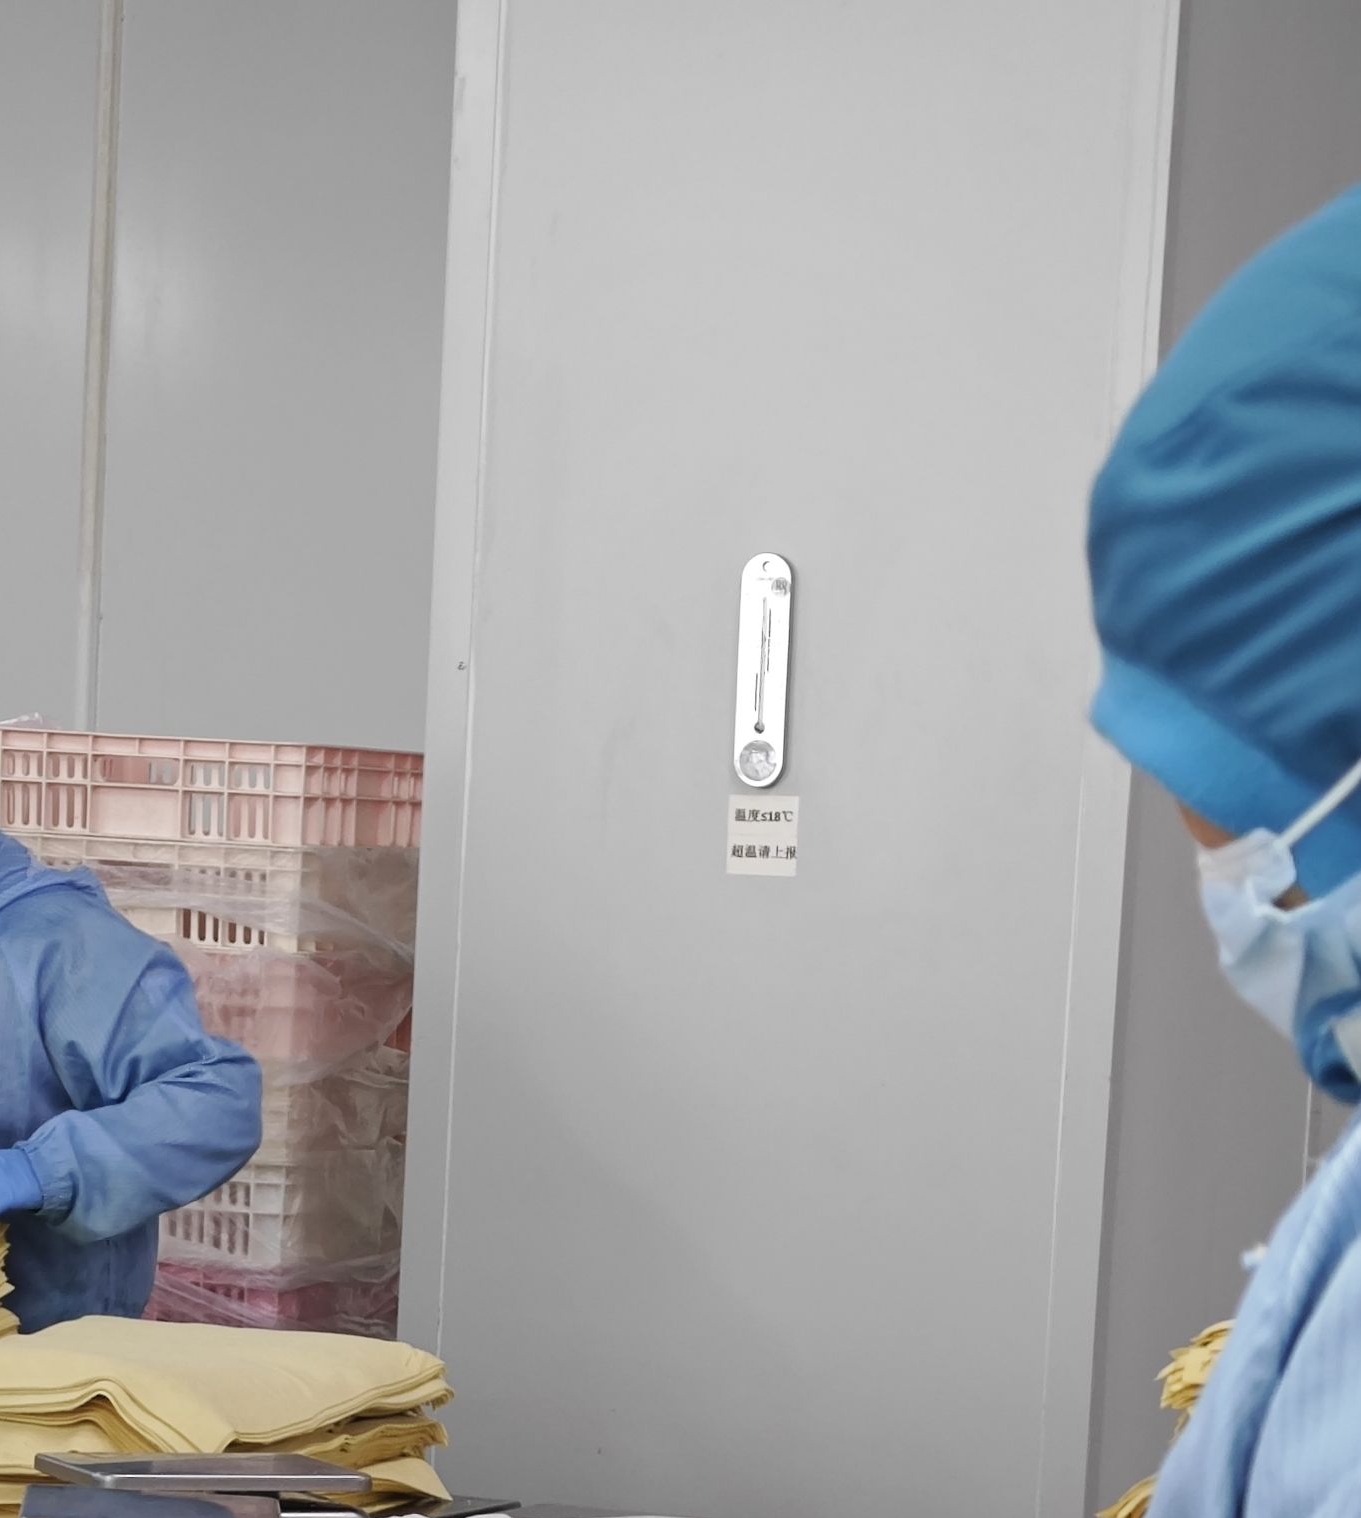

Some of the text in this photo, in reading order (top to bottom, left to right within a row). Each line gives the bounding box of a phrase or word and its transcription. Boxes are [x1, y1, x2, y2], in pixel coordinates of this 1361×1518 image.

[731, 844, 797, 860] 超温请上报
